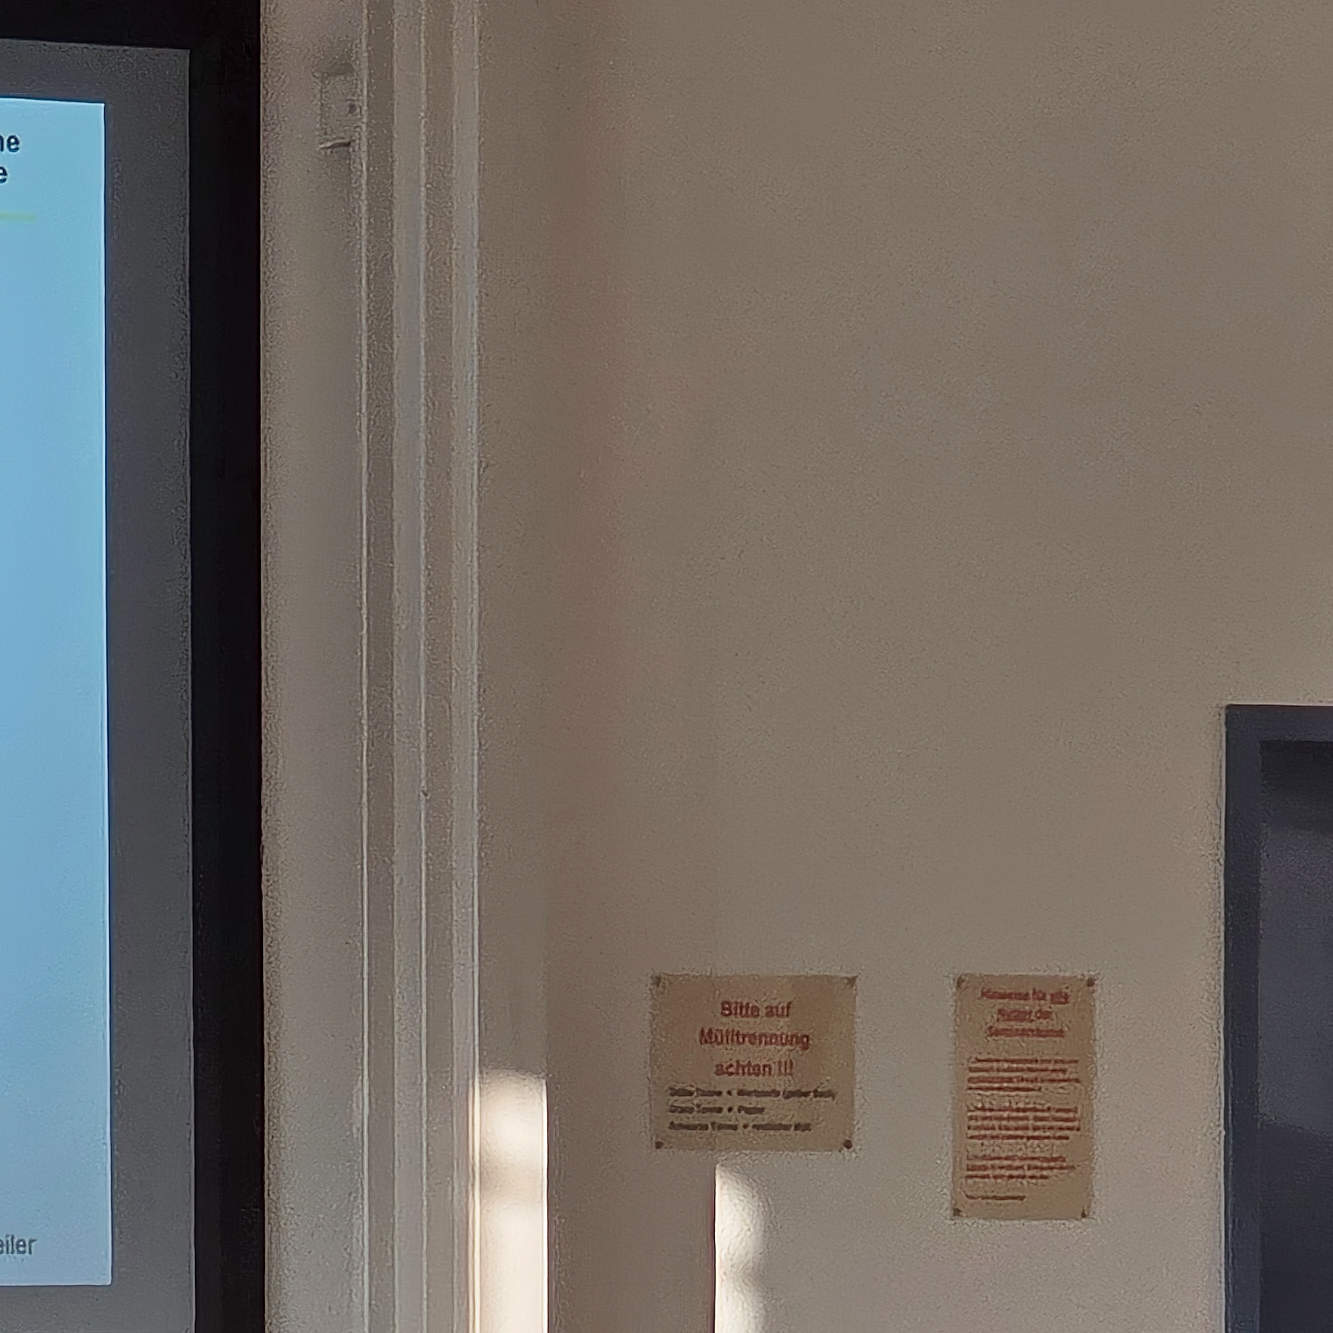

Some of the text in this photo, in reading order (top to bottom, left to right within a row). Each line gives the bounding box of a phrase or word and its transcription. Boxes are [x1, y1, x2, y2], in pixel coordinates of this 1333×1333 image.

[720, 999, 793, 1019] Bitte auf
[699, 1027, 811, 1051] Mülltrennung
[714, 1060, 772, 1077] achten
